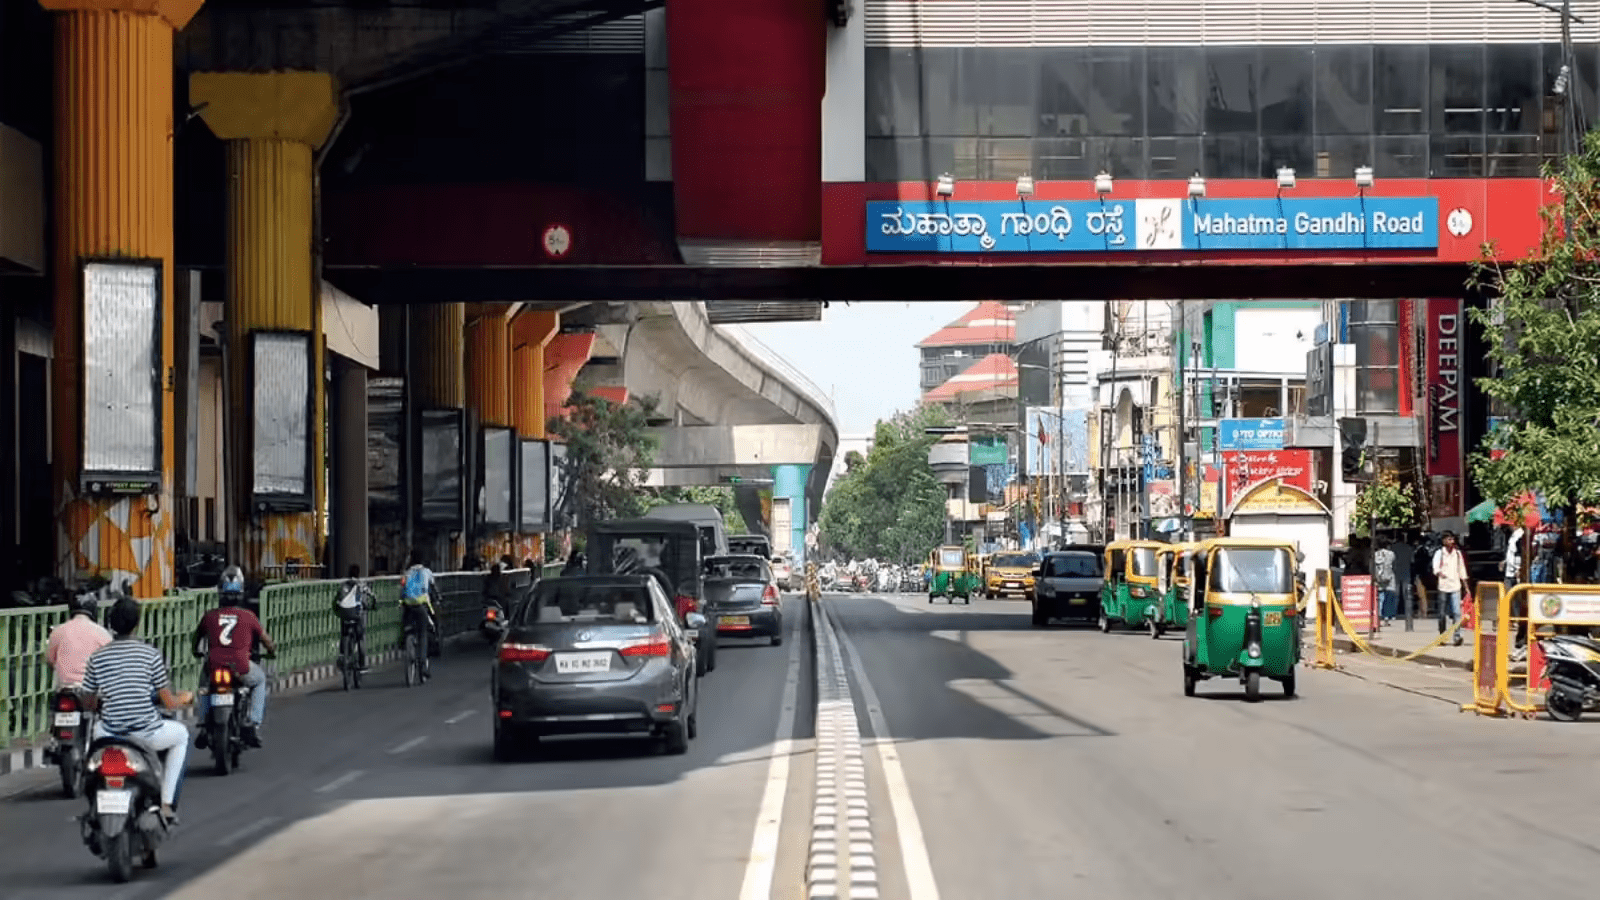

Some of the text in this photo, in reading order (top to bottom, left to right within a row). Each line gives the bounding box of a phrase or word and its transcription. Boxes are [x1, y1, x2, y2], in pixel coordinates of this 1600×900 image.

[1086, 204, 1127, 245] ರಸ್ತೆ
[1193, 211, 1424, 234] Mahatma Gandhi Road
[1439, 313, 1457, 432] DEEPAM
[218, 618, 238, 646] 7
